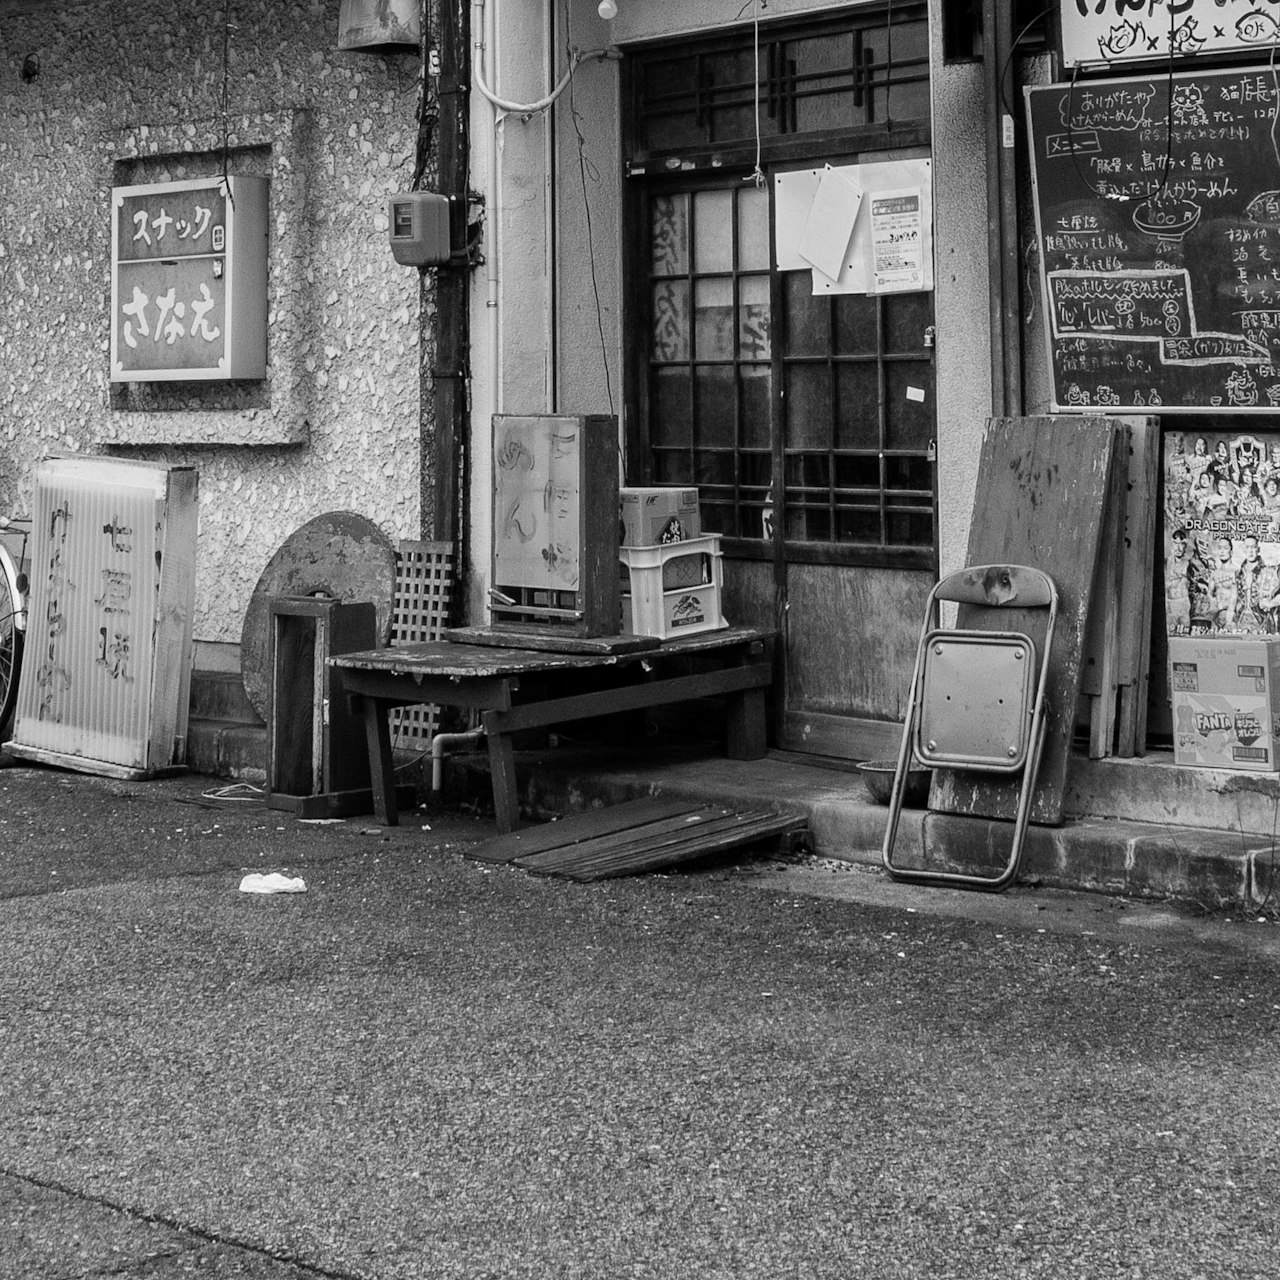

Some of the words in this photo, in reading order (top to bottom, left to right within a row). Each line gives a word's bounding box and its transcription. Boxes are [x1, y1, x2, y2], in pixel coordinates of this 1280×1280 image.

[1081, 90, 1147, 111] ありがたや
[133, 205, 211, 246] スナック
[122, 283, 220, 349] さなえ
[1184, 519, 1269, 534] DRAGONGATE
[1196, 713, 1232, 730] FANTA
